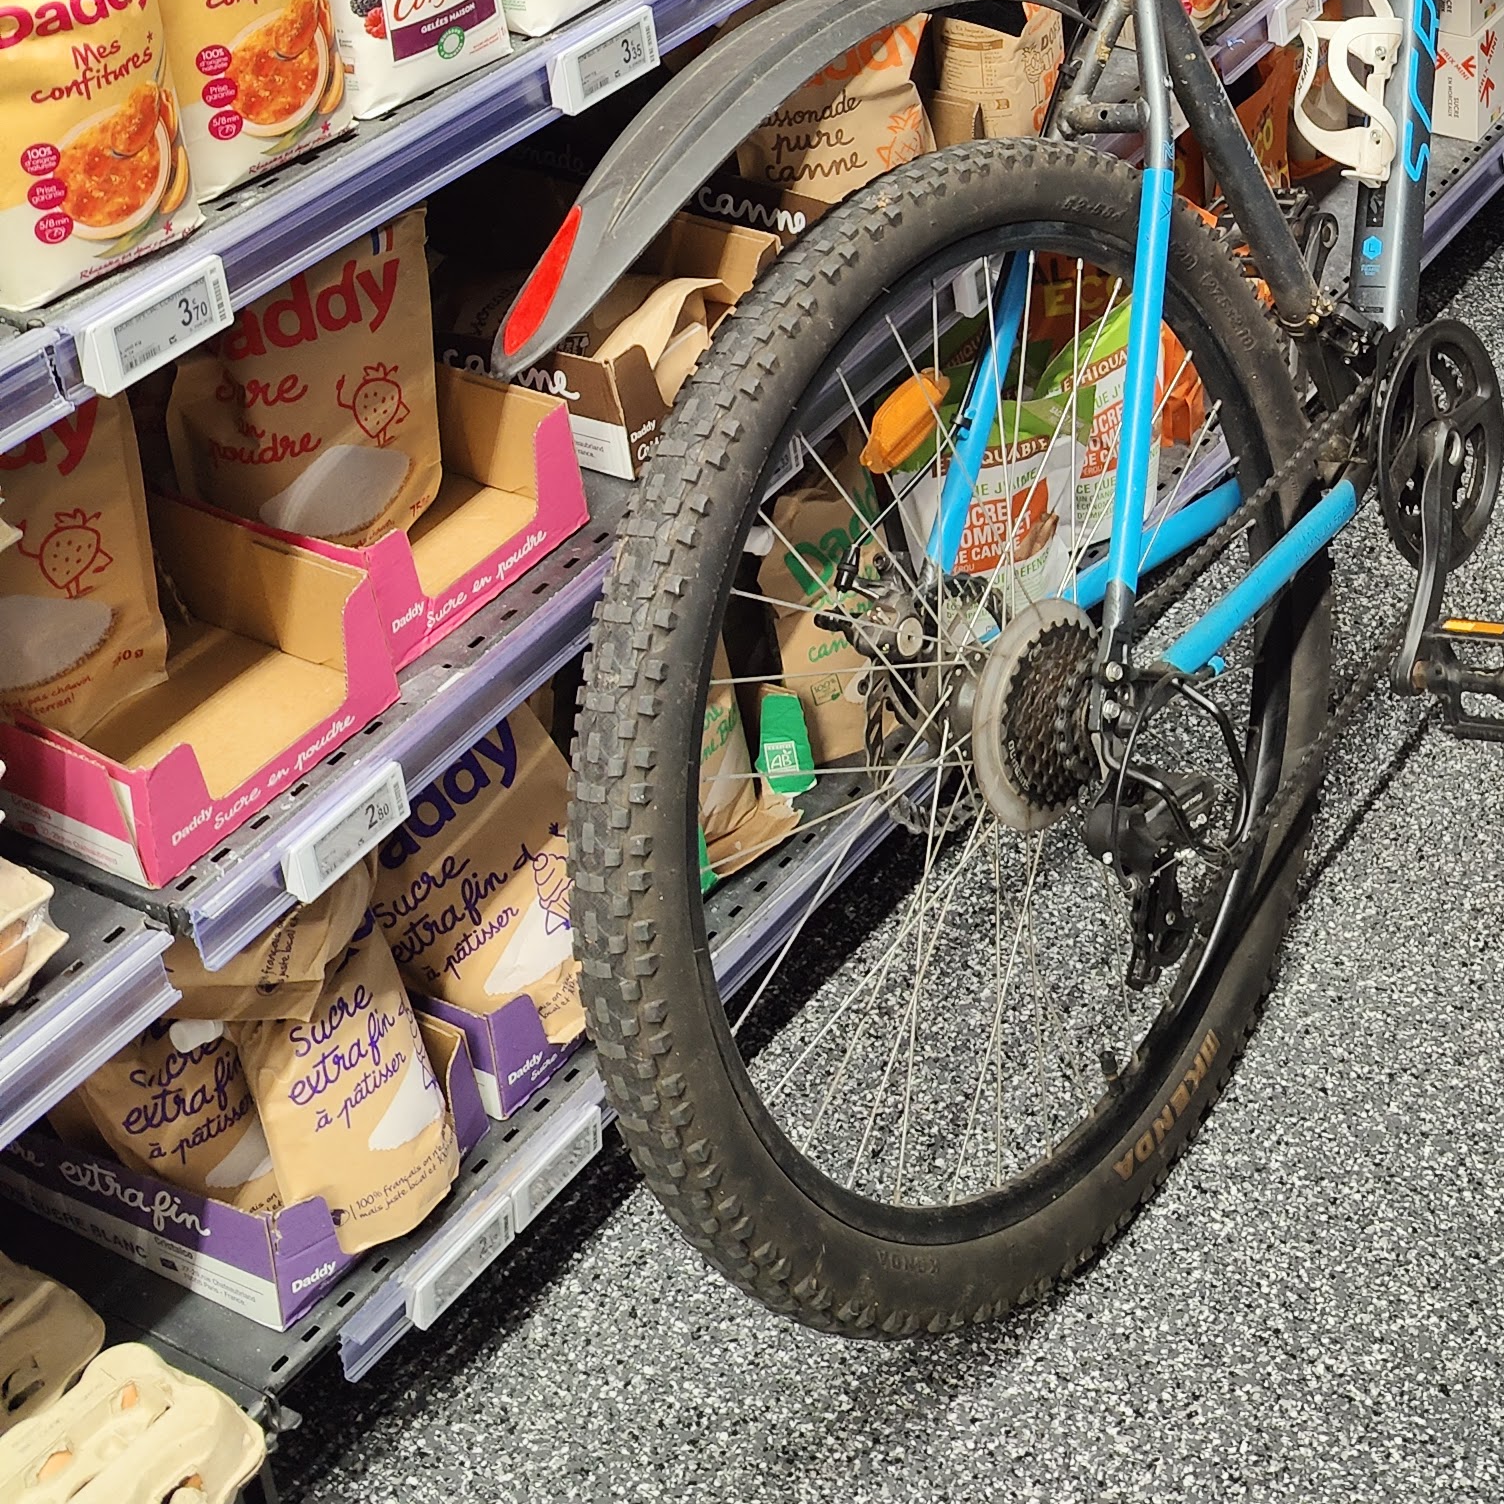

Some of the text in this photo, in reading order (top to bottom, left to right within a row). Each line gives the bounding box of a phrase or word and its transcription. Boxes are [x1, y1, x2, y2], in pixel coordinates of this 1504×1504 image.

[420, 2, 476, 35] GELÉES MAISON
[71, 39, 121, 71] Mes
[30, 47, 153, 104] confitures
[25, 145, 54, 161] 100%
[772, 126, 856, 157] pure
[765, 155, 867, 184] canne
[33, 184, 58, 198] Prise
[699, 186, 807, 235] canne
[1368, 242, 1375, 253] L
[426, 527, 548, 630] Sucre en poudre
[391, 598, 425, 634] Daddy
[214, 714, 356, 831] Sucre en poudre
[171, 804, 214, 848] Daddy
[443, 903, 520, 976] pâtisser
[289, 980, 376, 1059] Sucre
[288, 1043, 368, 1109] extra
[507, 1048, 544, 1086] Daddy
[337, 1047, 409, 1130] pâtisser
[290, 1259, 337, 1293] Daddy
